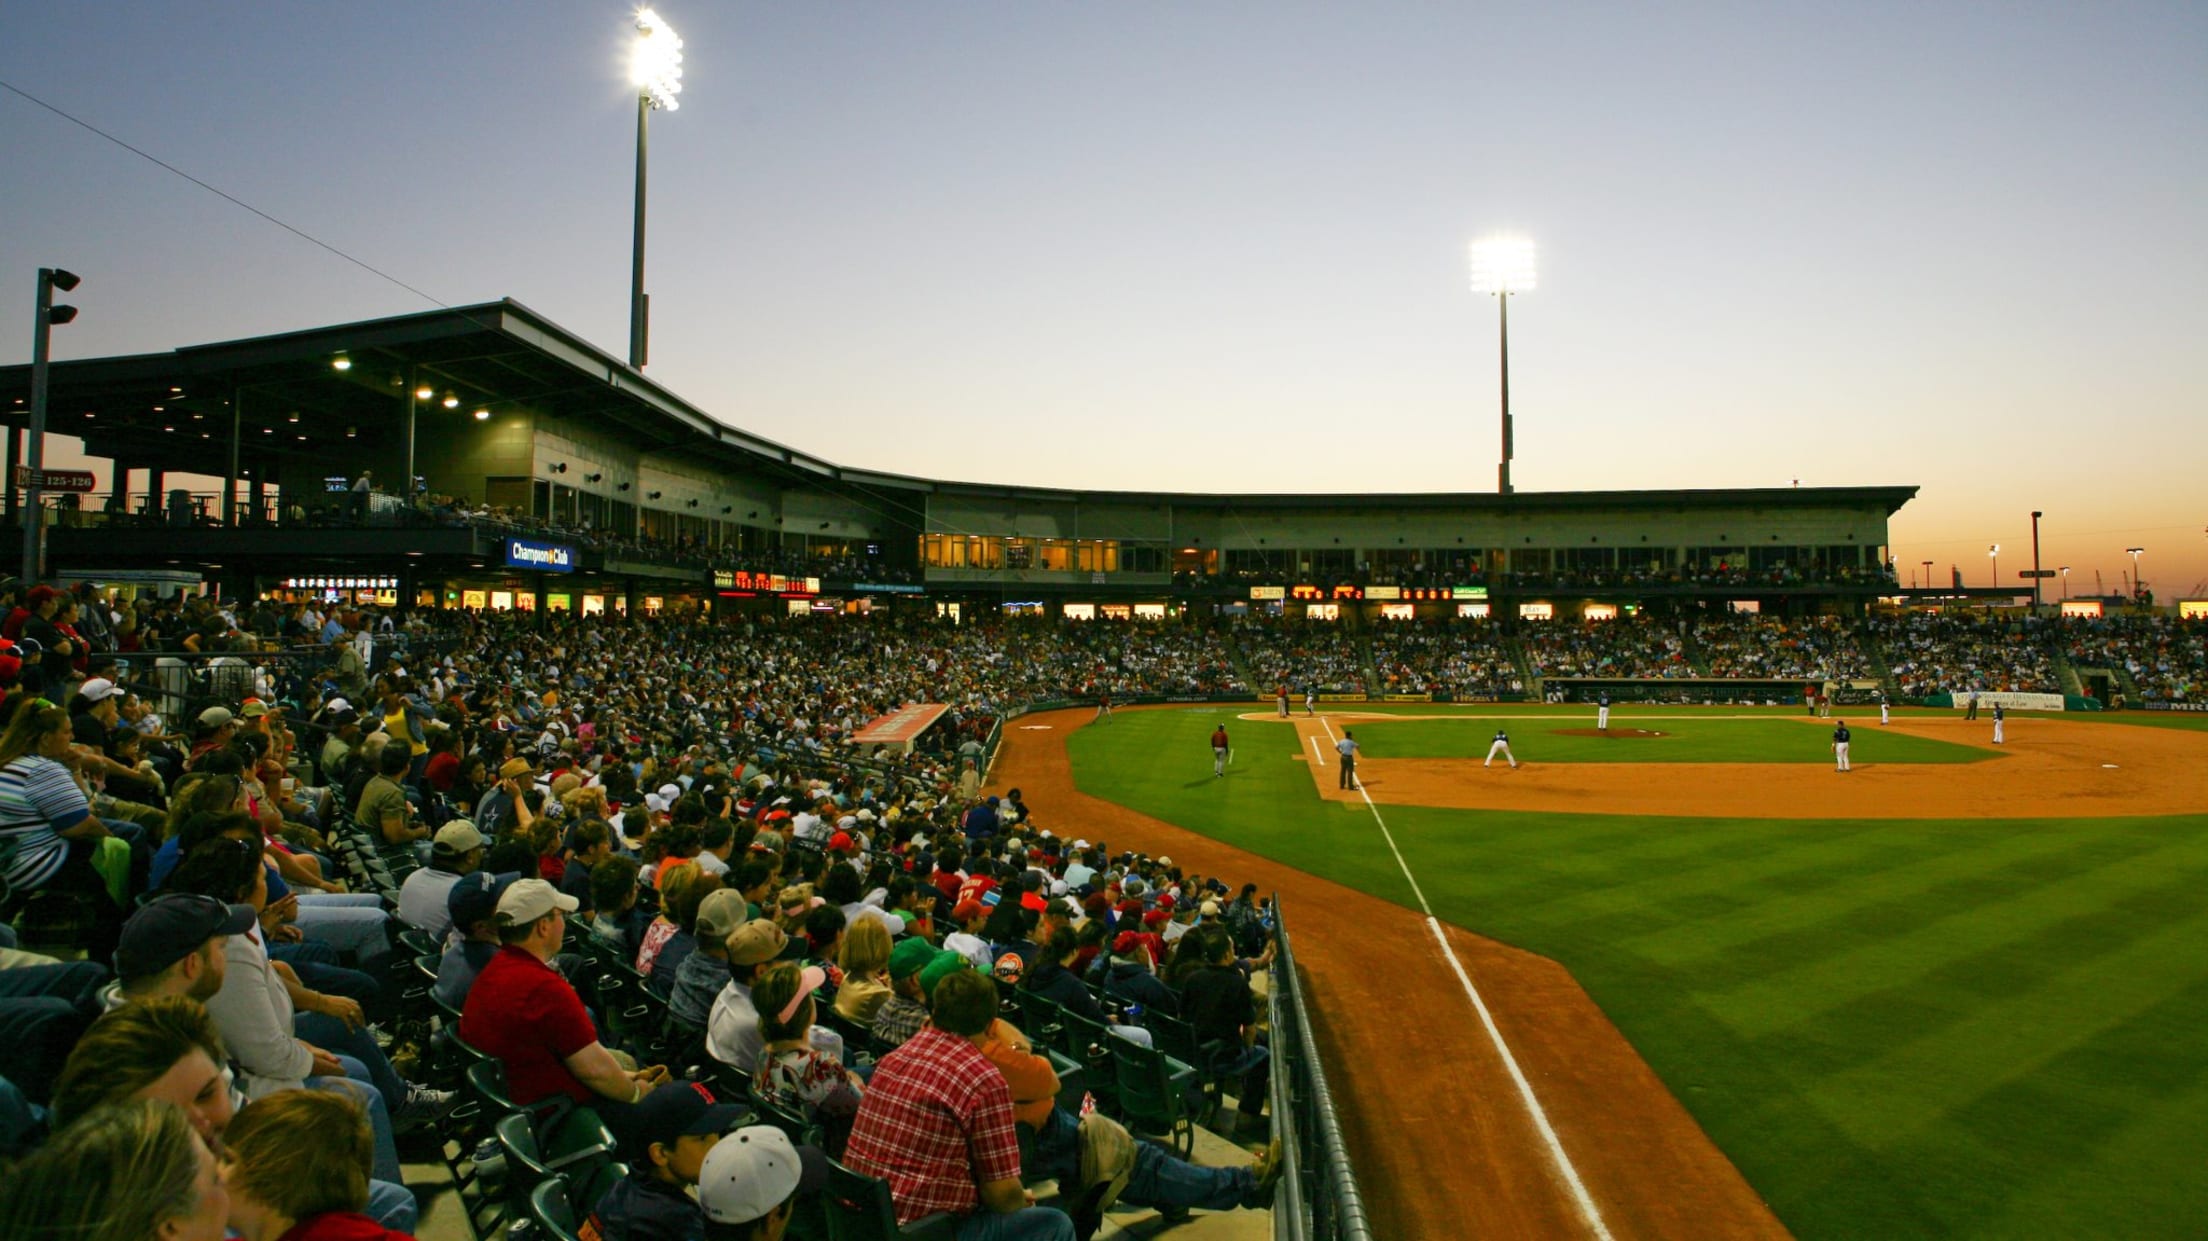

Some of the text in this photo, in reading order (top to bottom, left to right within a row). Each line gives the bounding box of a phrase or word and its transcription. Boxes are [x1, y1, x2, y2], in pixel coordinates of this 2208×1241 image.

[47, 476, 92, 487] 125-126
[554, 548, 568, 565] Club
[288, 579, 398, 588] REFRESHMENT
[2170, 703, 2208, 711] MR
